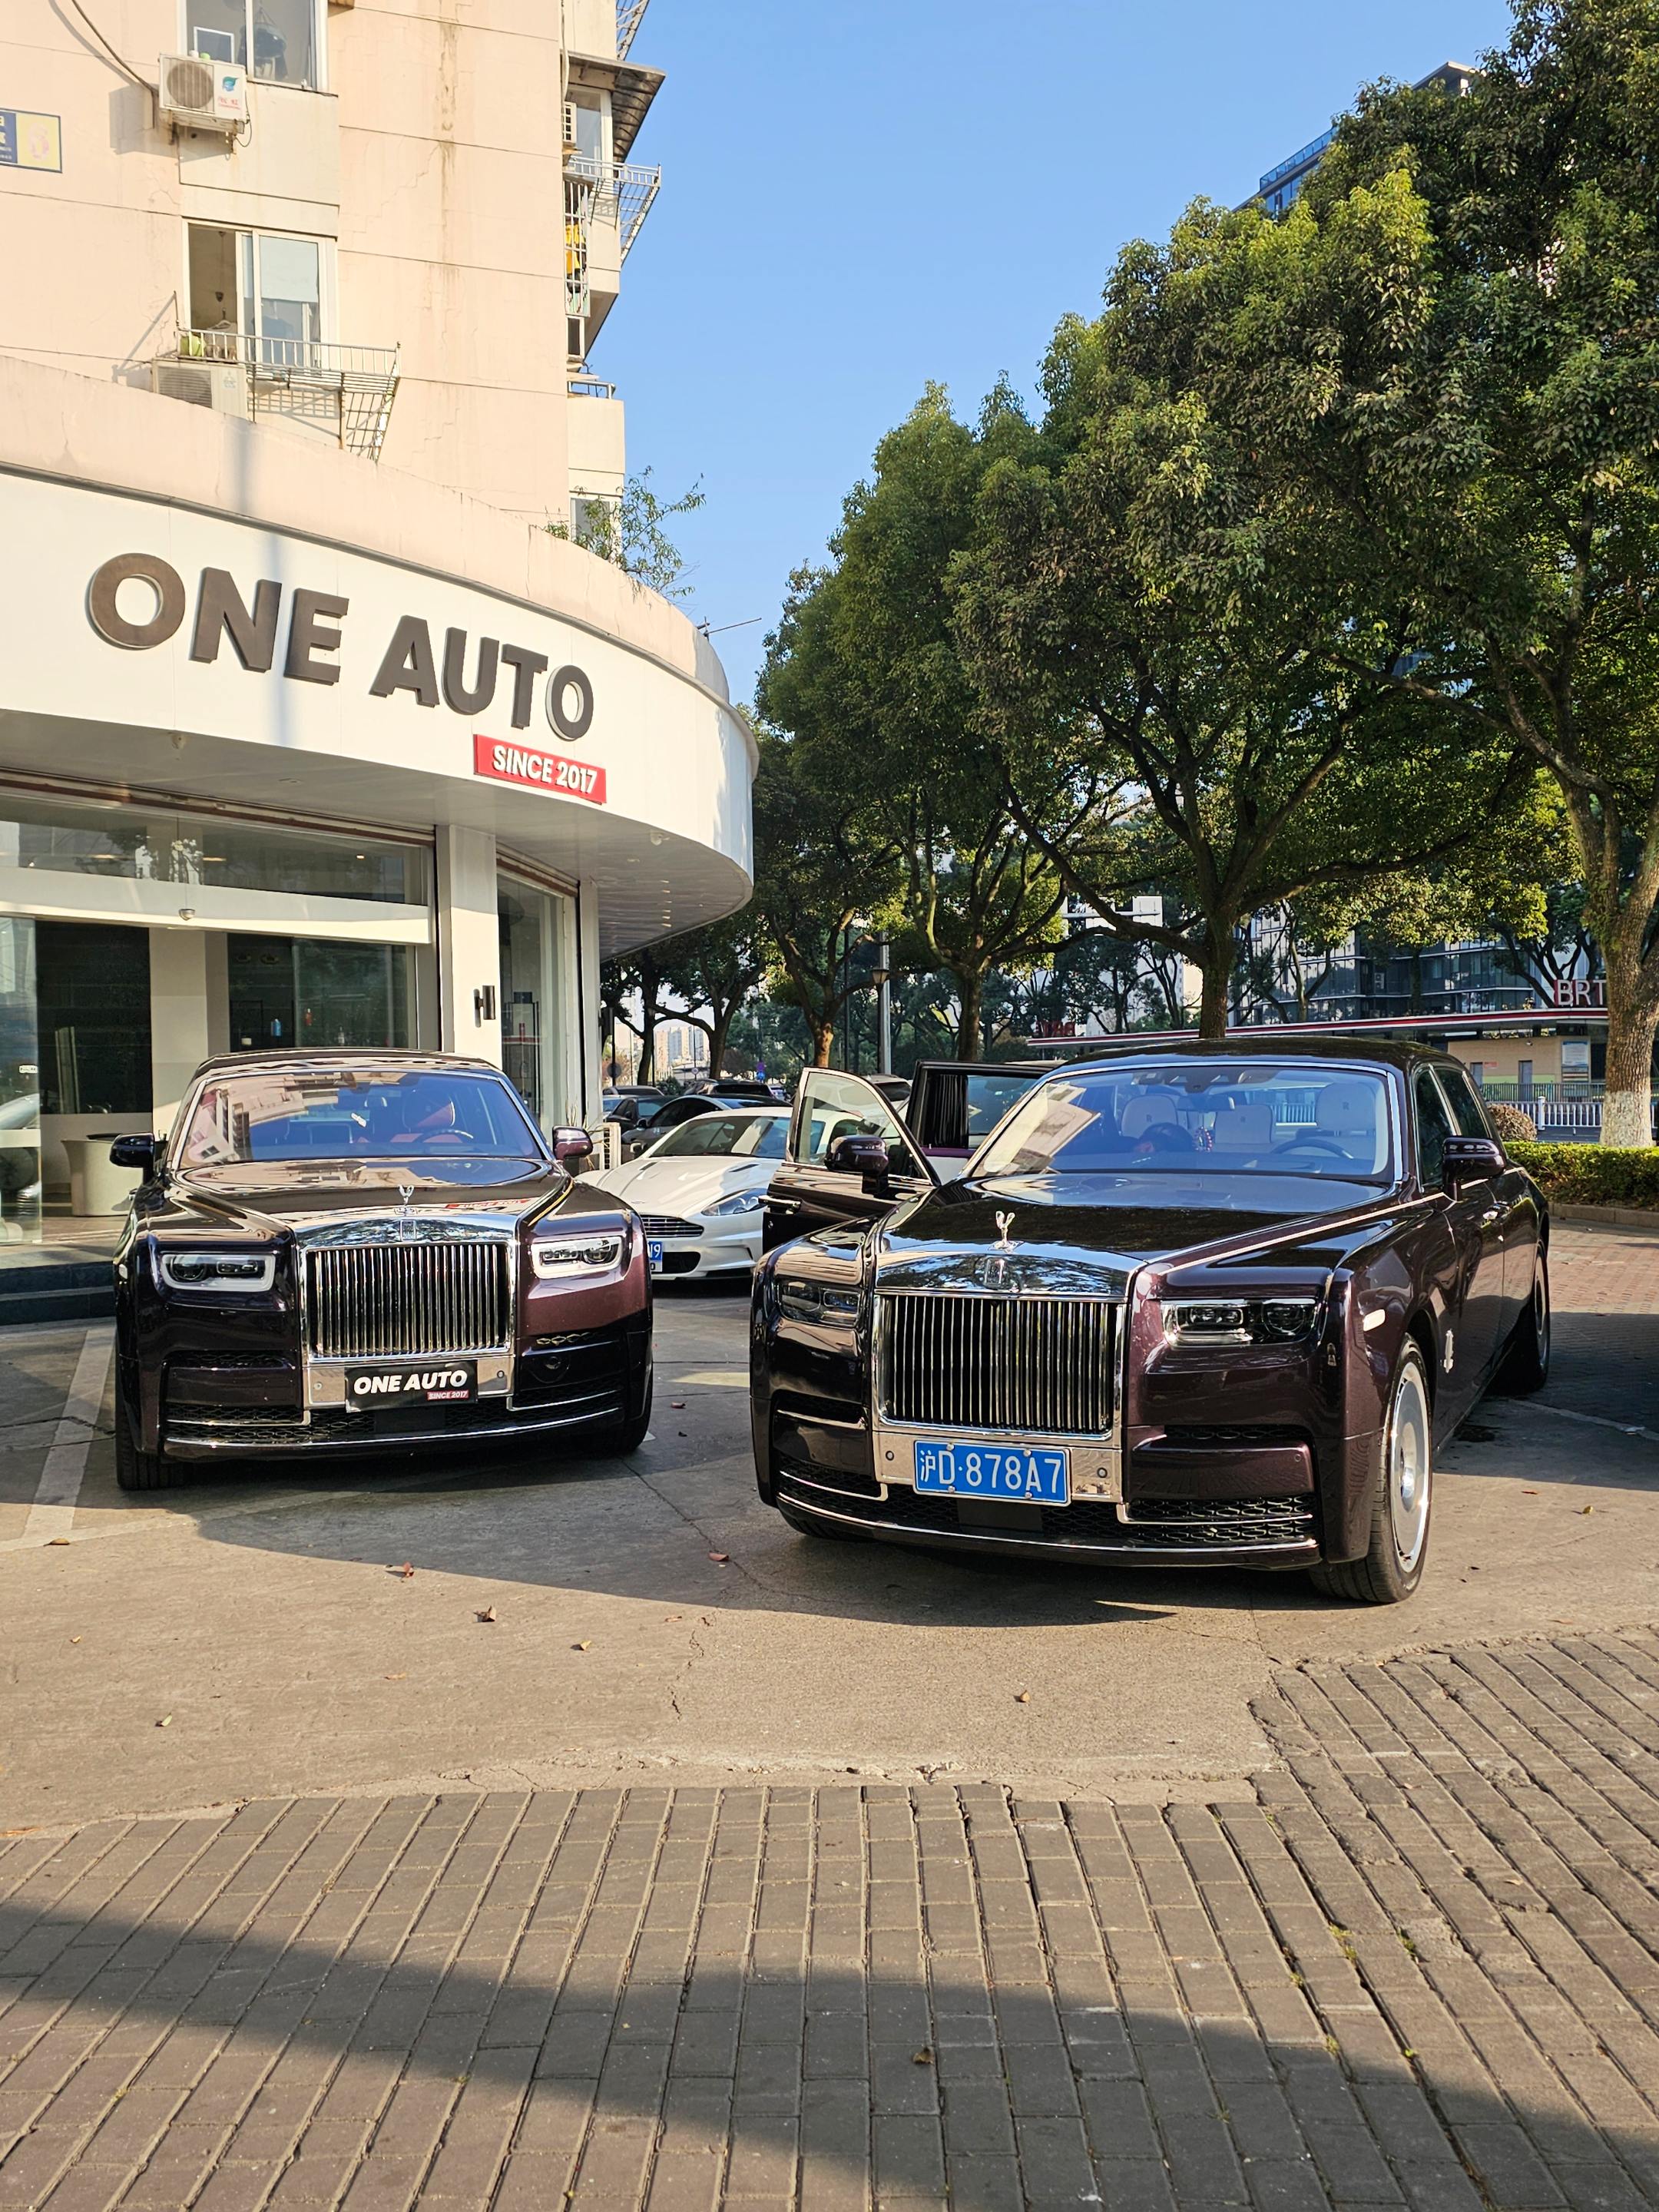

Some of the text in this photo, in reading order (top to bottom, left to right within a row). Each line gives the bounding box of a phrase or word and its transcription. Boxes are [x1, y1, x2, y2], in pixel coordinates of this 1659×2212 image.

[84, 552, 594, 742] ONE AUTO
[492, 745, 598, 793] SINCE 2017
[1557, 979, 1607, 1005] BRT
[353, 1369, 468, 1395] ONE AUTO
